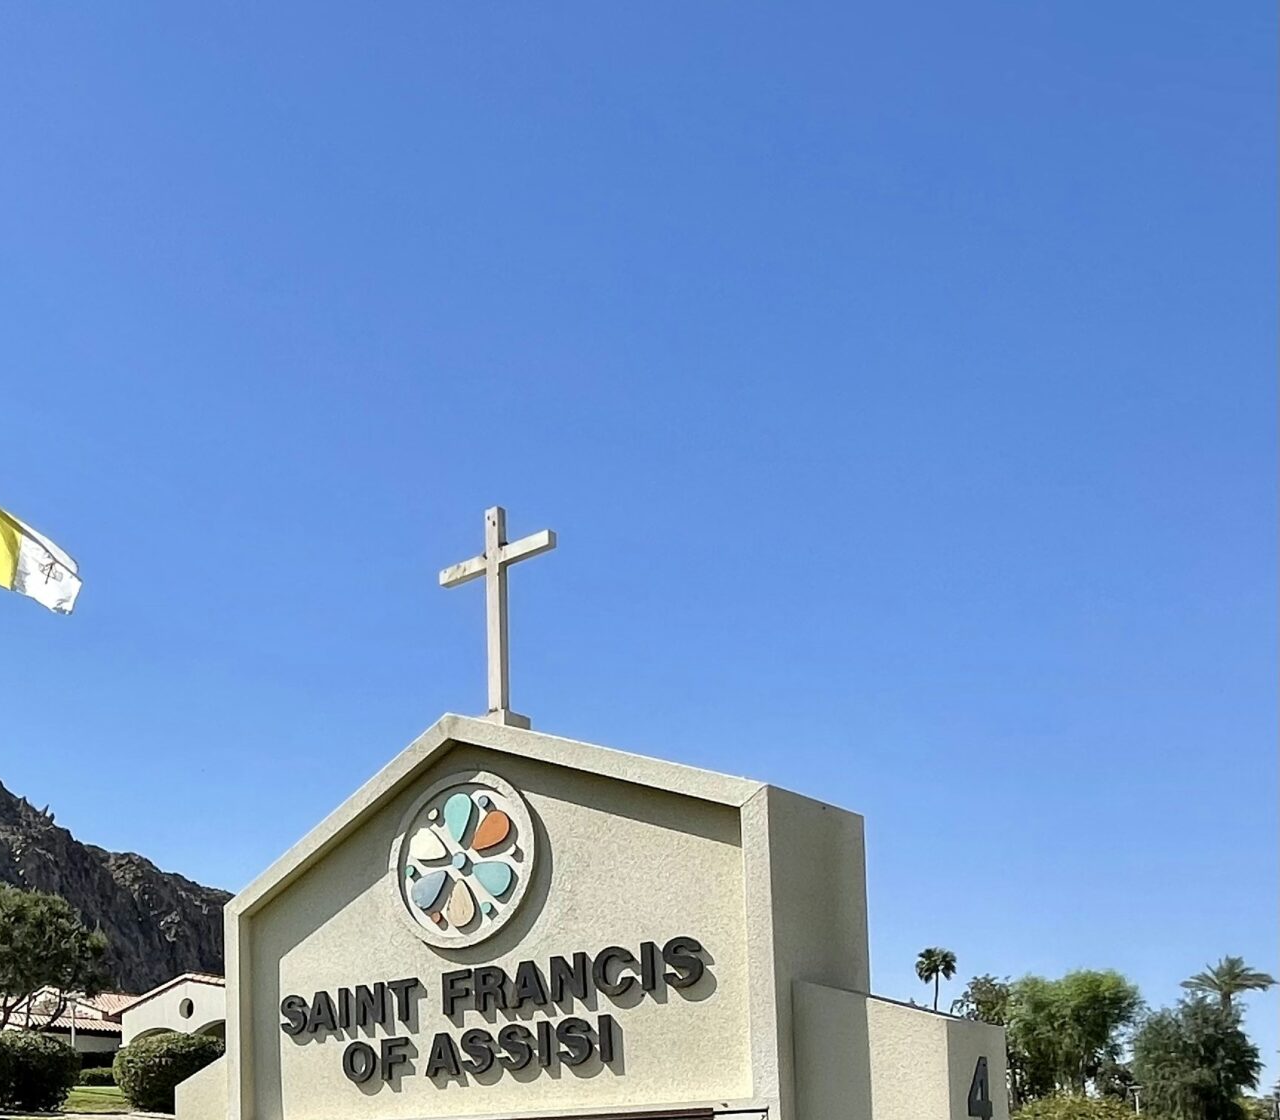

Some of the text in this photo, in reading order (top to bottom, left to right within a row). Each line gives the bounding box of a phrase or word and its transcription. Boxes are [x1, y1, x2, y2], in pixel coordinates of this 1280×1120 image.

[280, 936, 705, 1036] SAINT FRANCIS
[342, 1014, 614, 1085] OF ASSISI
